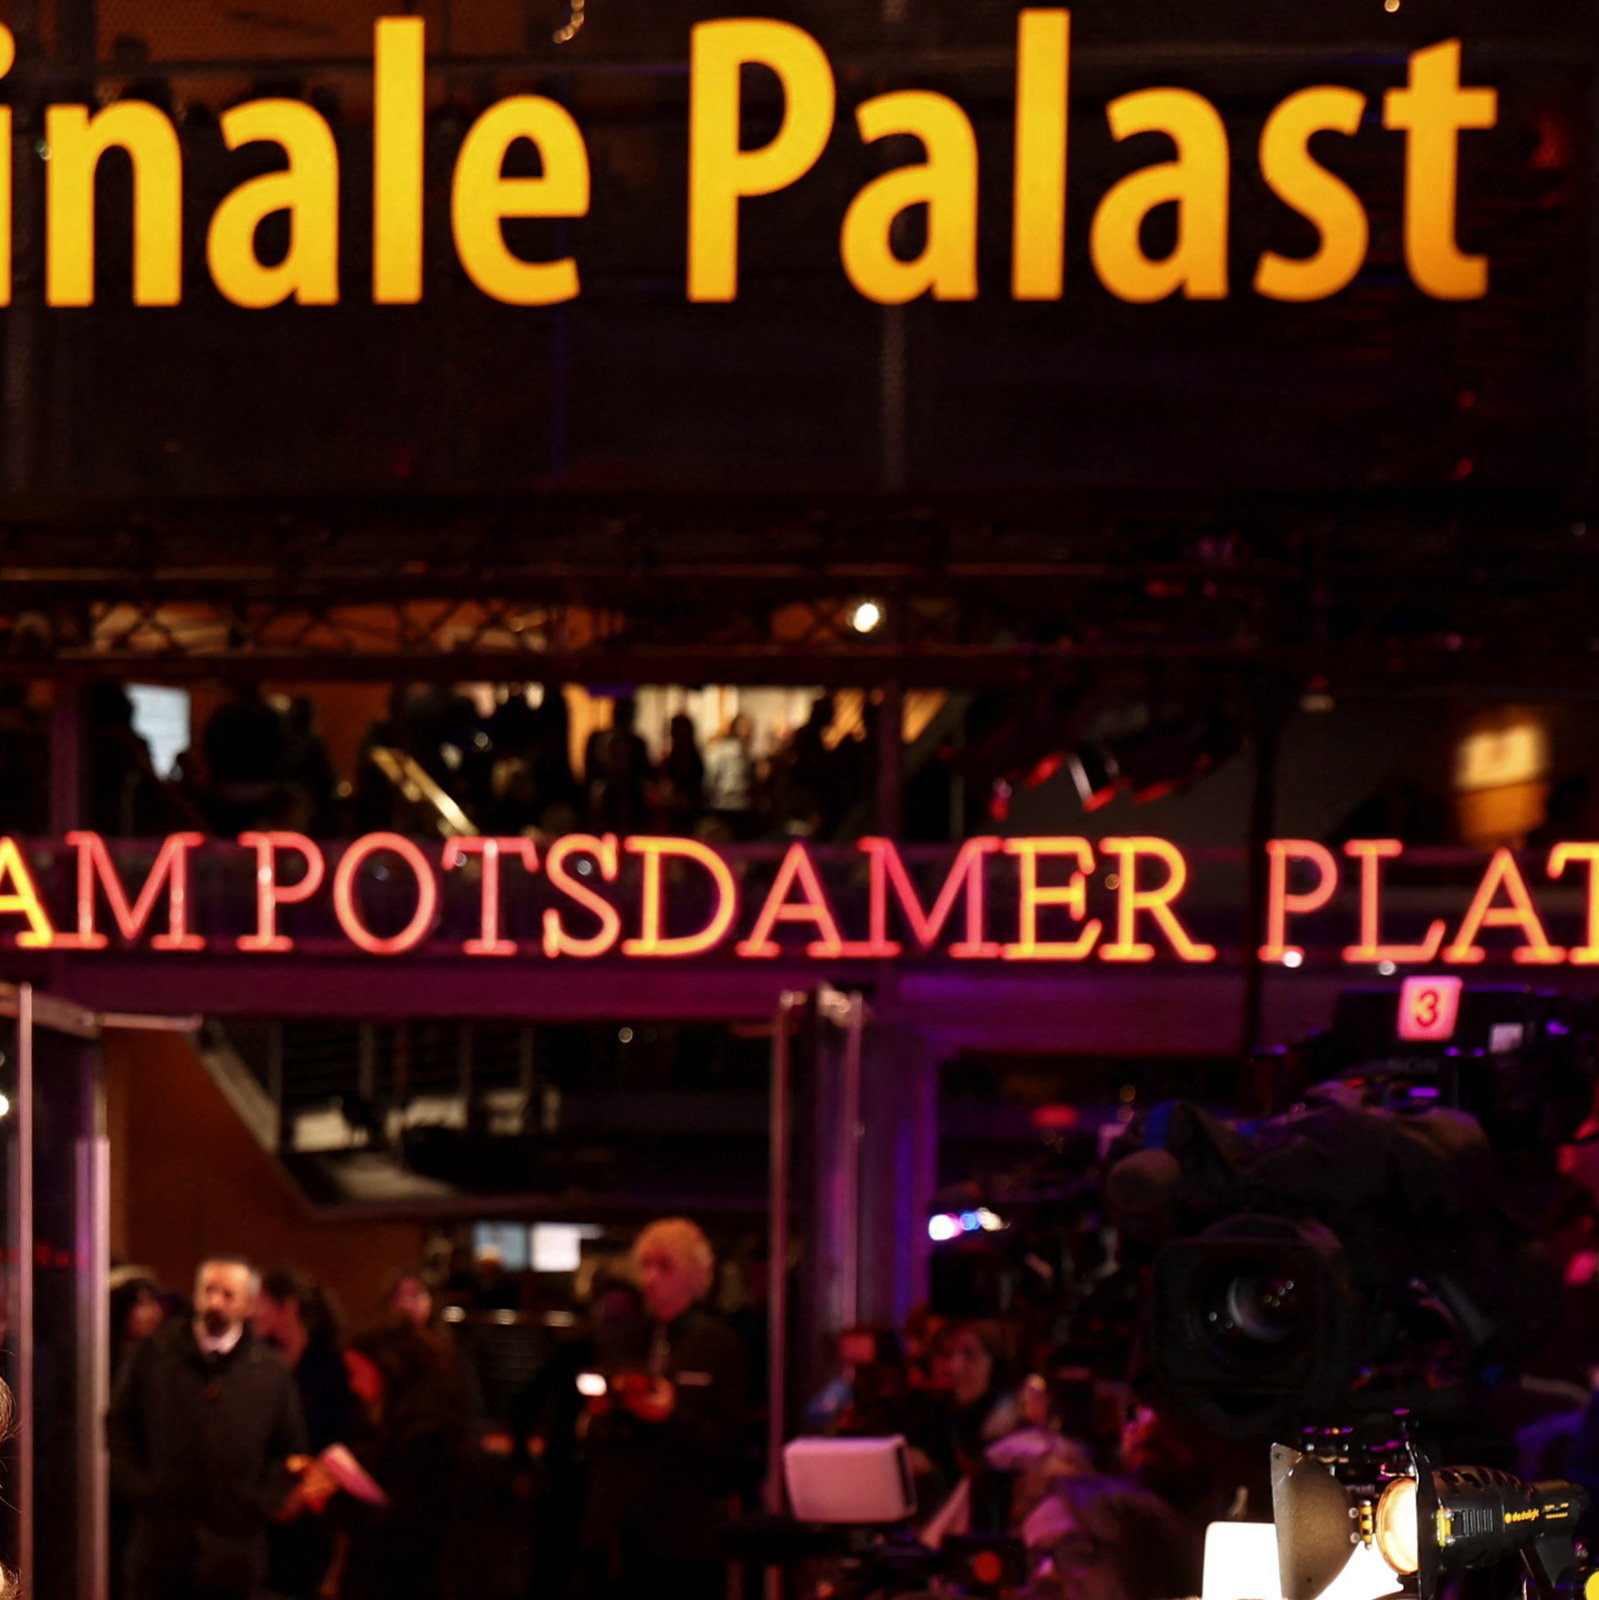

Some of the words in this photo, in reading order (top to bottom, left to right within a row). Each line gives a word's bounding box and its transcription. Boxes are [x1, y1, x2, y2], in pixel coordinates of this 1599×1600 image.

[686, 9, 1497, 303] Palast
[236, 831, 1217, 963] POTSDAMER
[1416, 990, 1439, 1027] 3
